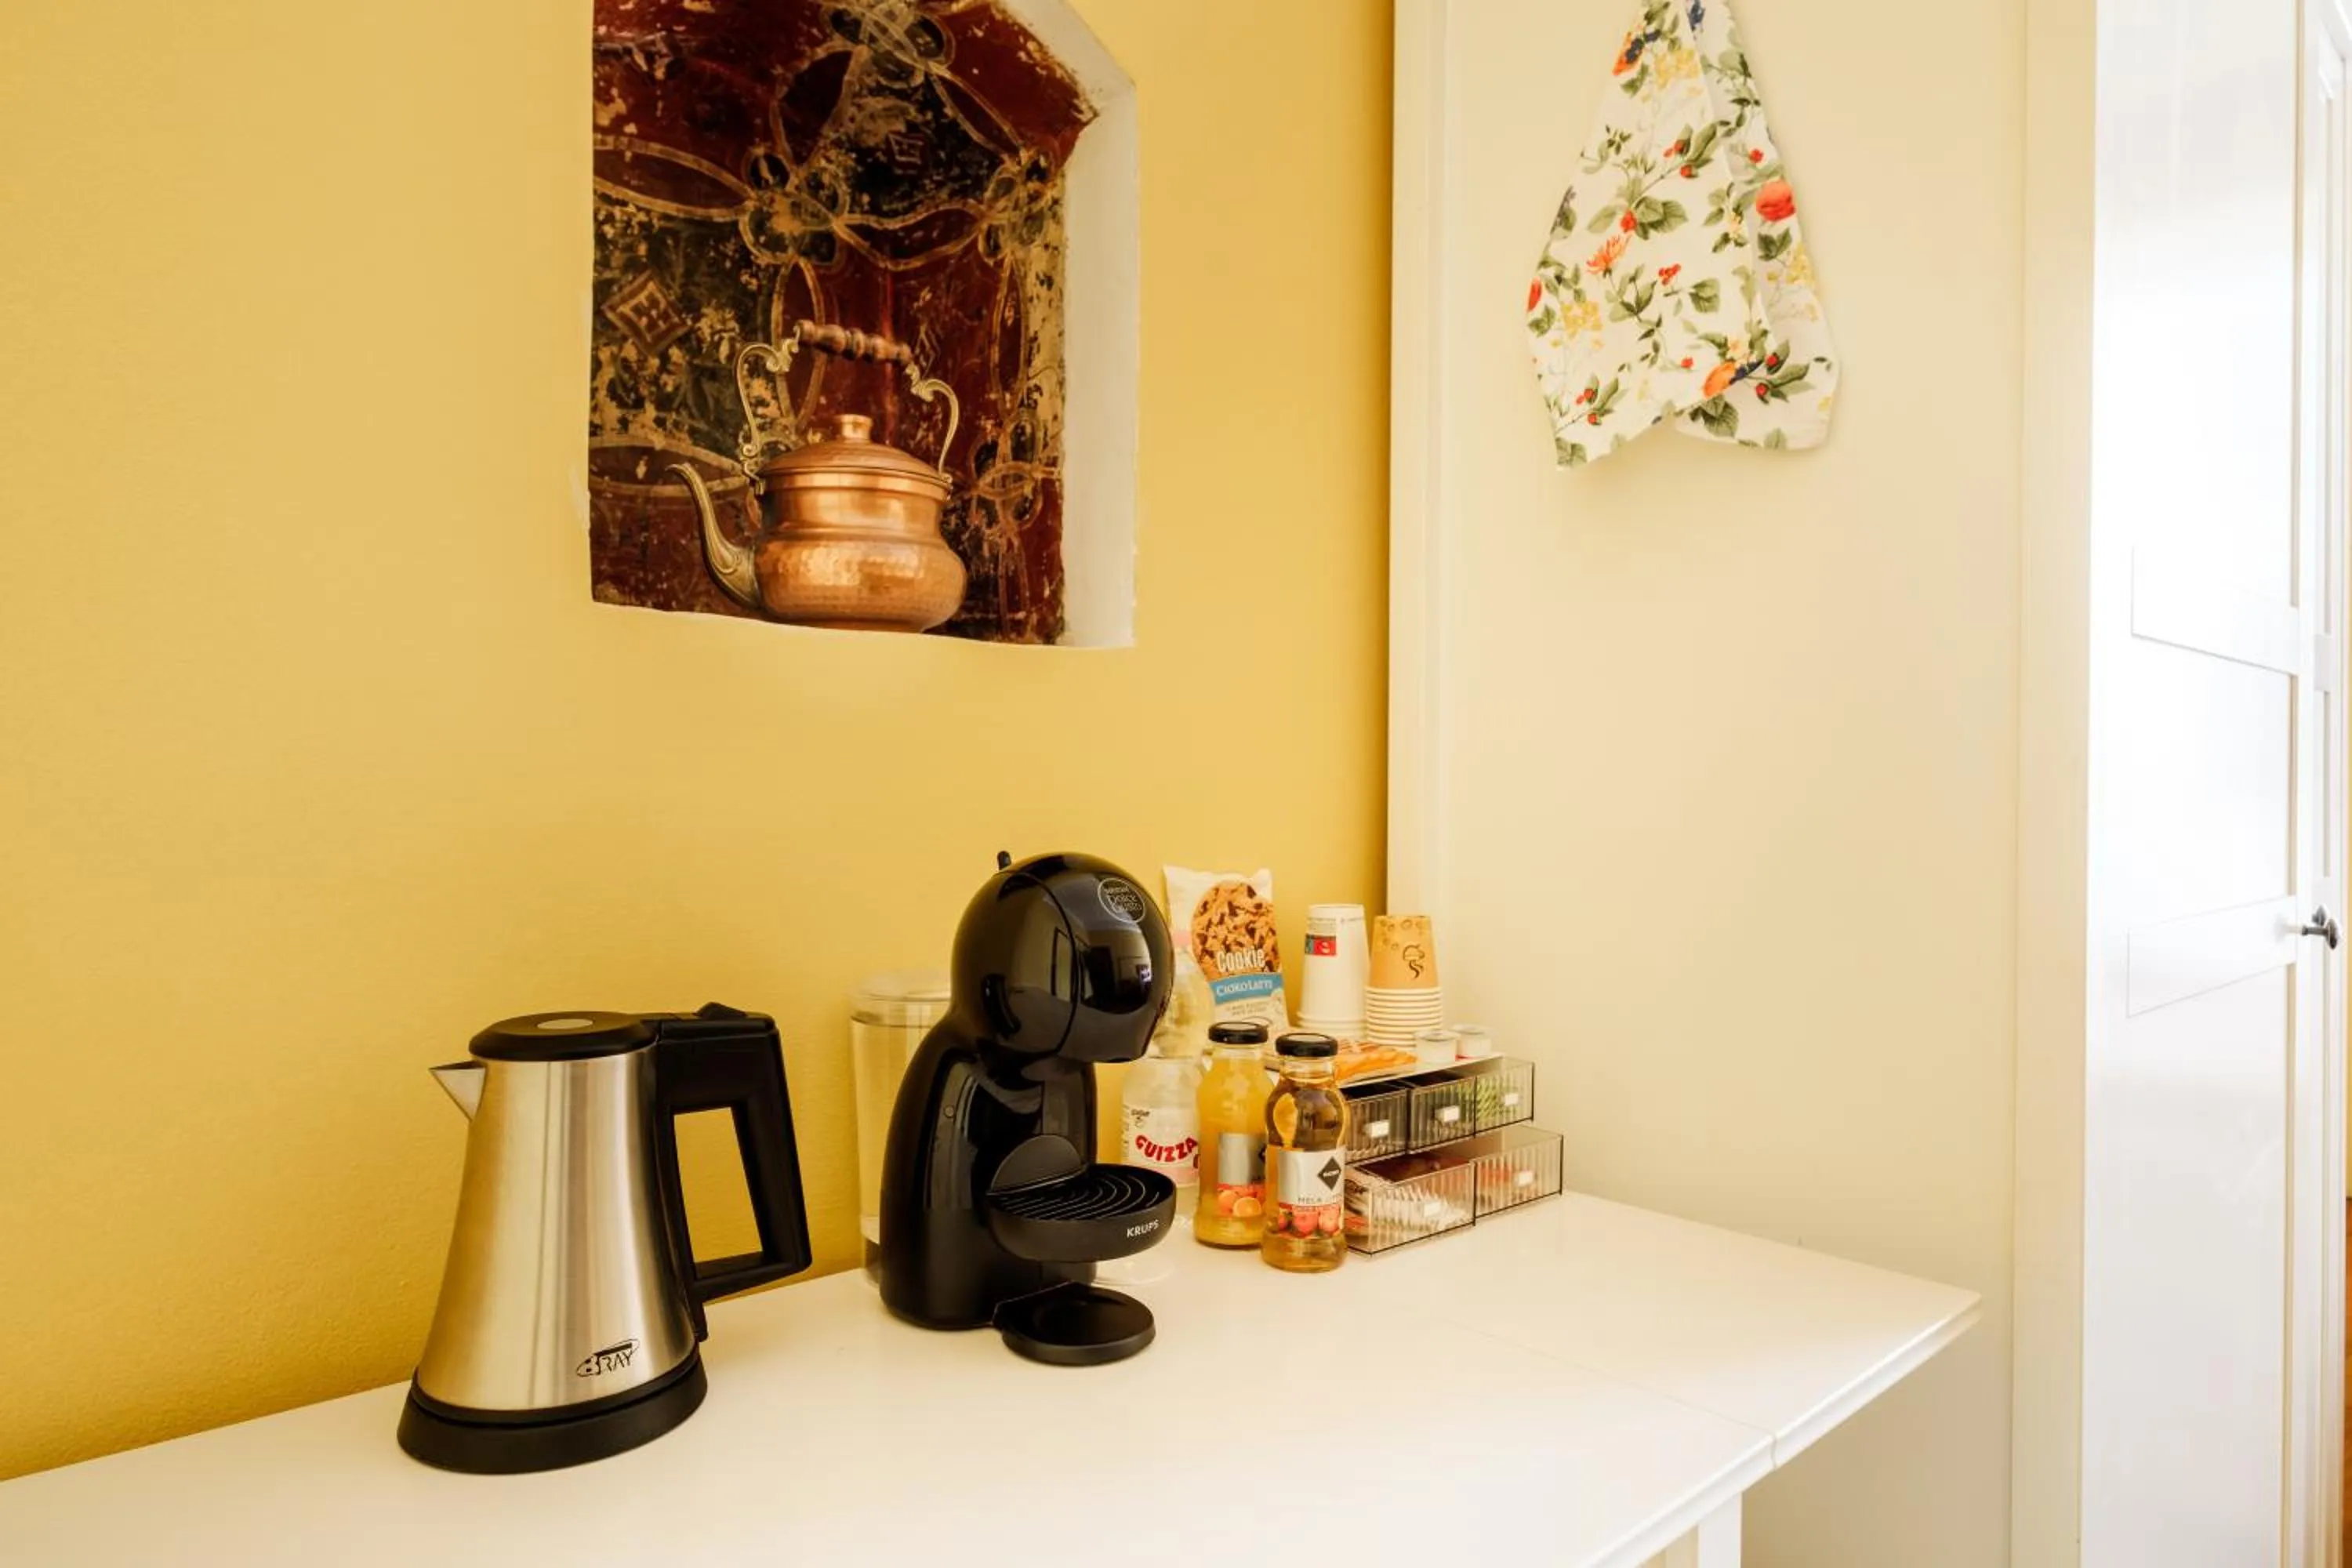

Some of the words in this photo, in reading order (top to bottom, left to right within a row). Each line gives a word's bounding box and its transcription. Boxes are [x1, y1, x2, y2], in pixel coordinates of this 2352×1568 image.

[1217, 946, 1265, 972] Cookie
[1135, 1134, 1198, 1163] GUIZZA
[1127, 1219, 1160, 1238] KRUPS
